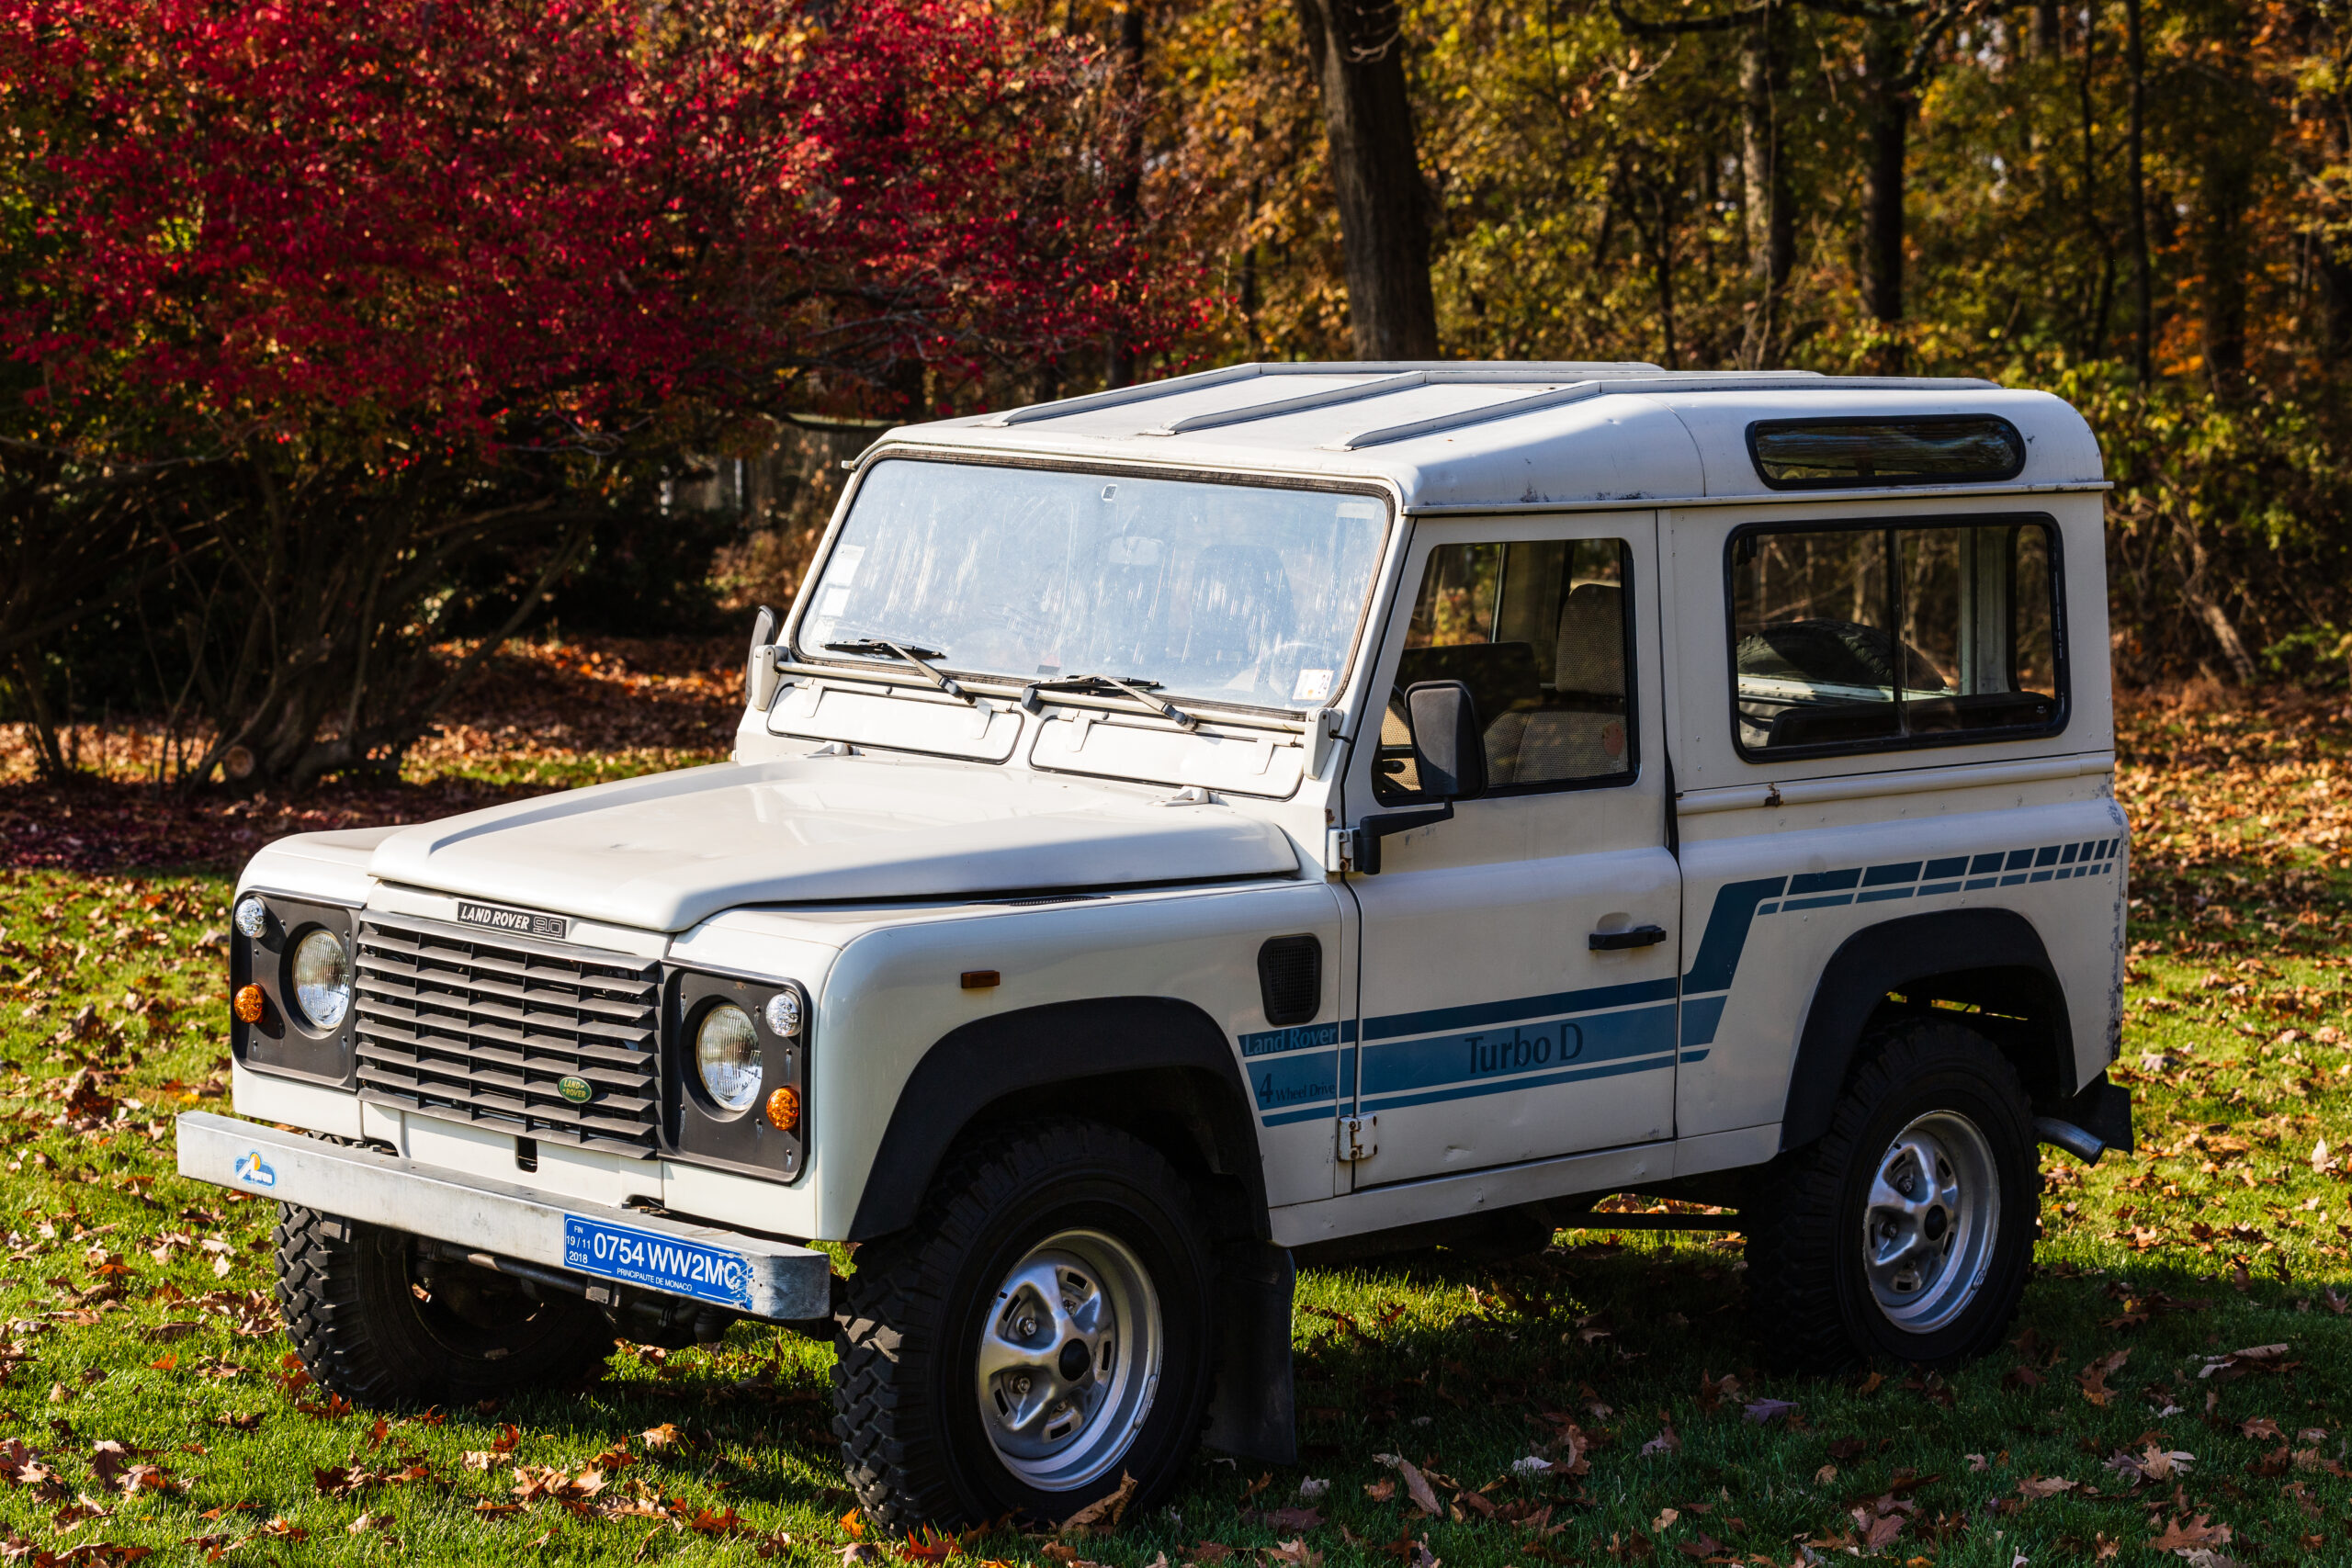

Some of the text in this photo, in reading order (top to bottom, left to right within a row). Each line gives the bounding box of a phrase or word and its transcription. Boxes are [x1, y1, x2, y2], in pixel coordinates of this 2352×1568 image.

[460, 906, 563, 937] LAND ROVER 90
[1245, 1028, 1337, 1055] Land Rover
[1464, 1022, 1583, 1074] Turbo D
[563, 1079, 581, 1089] LAND
[565, 1089, 586, 1098] ROVER
[1259, 1073, 1336, 1102] 4 Wheel Drive
[574, 1225, 583, 1234] FIN
[569, 1250, 588, 1264] 2018
[594, 1232, 645, 1267] 0754
[616, 1268, 693, 1292] PRINCIPAUTE DE MONACO
